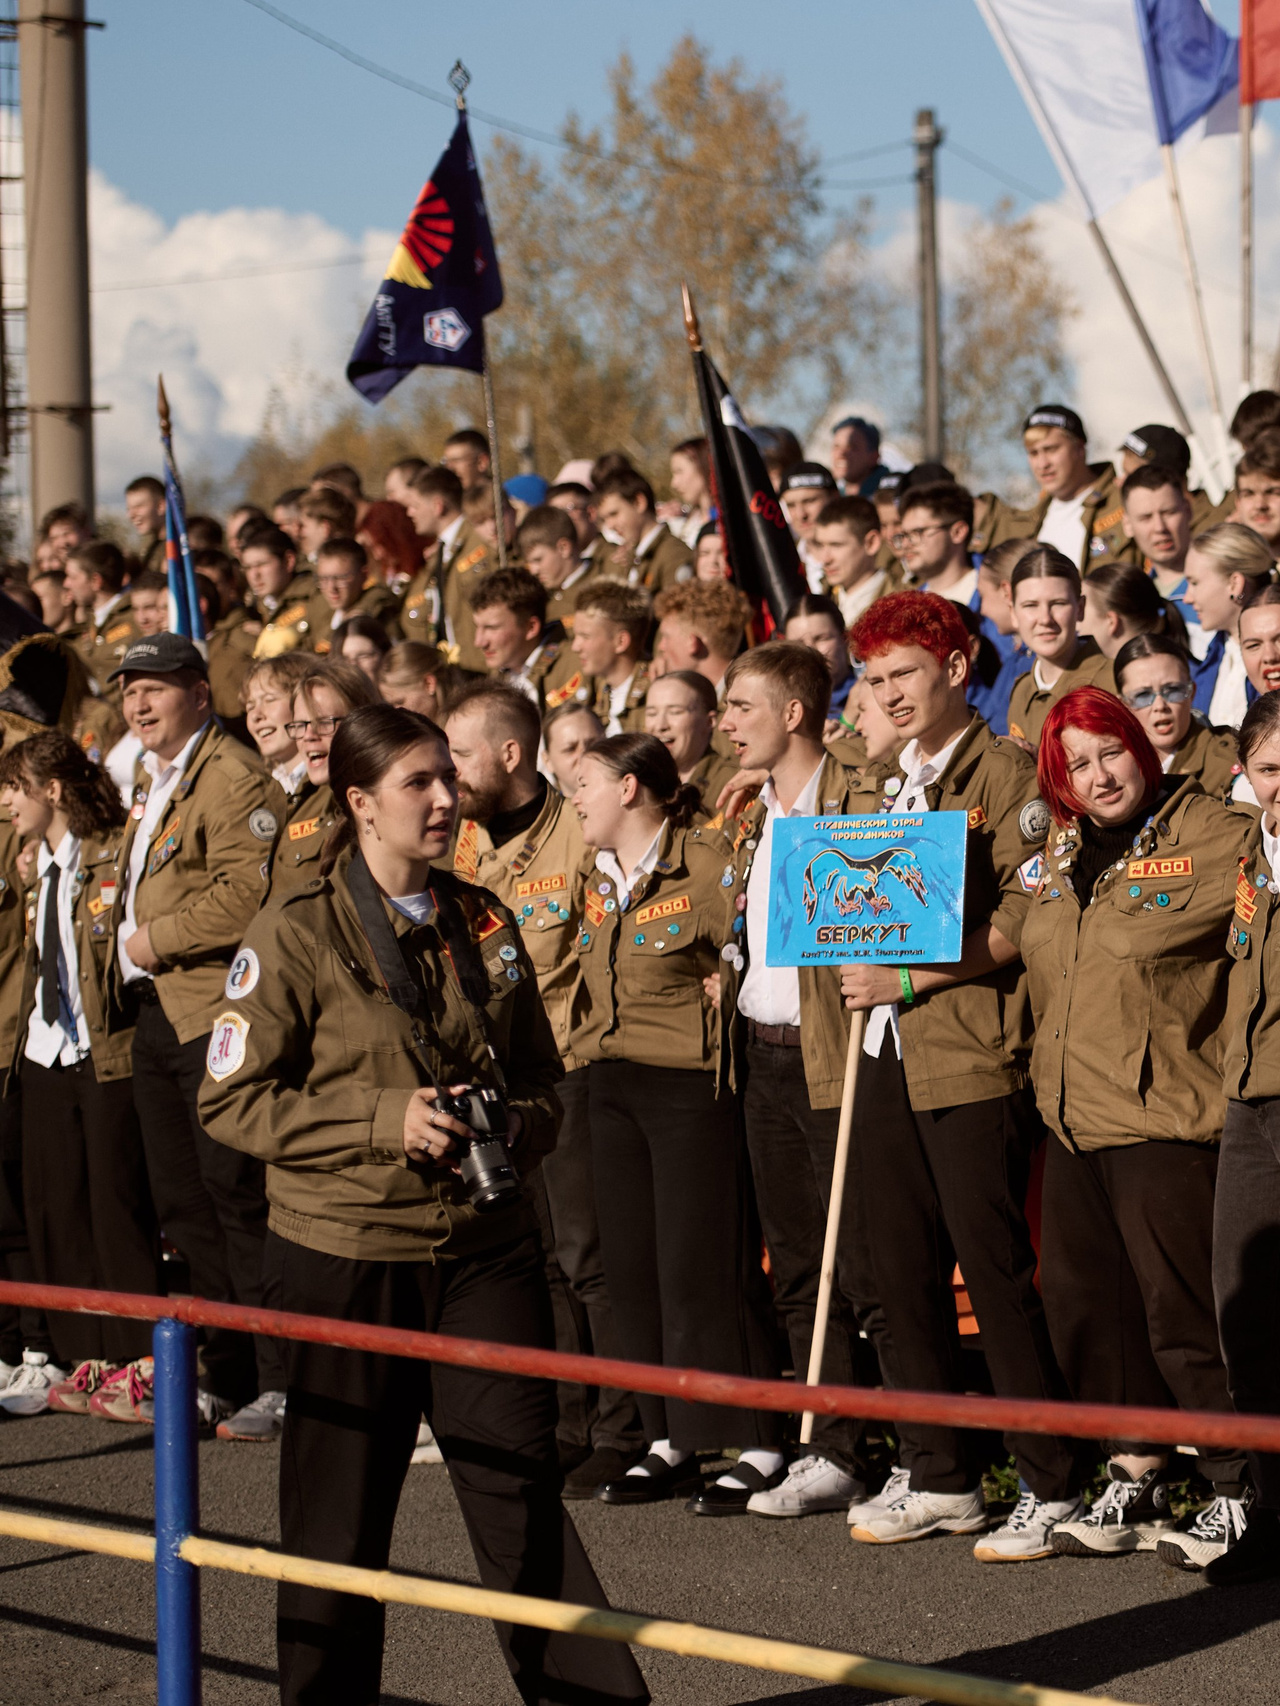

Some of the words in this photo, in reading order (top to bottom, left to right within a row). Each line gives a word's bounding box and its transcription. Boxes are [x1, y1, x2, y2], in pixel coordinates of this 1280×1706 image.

[892, 818, 924, 828] ОТРЯД
[831, 830, 905, 841] ПРОВОДНИКОВ
[815, 923, 912, 944] БЕРКУТ
